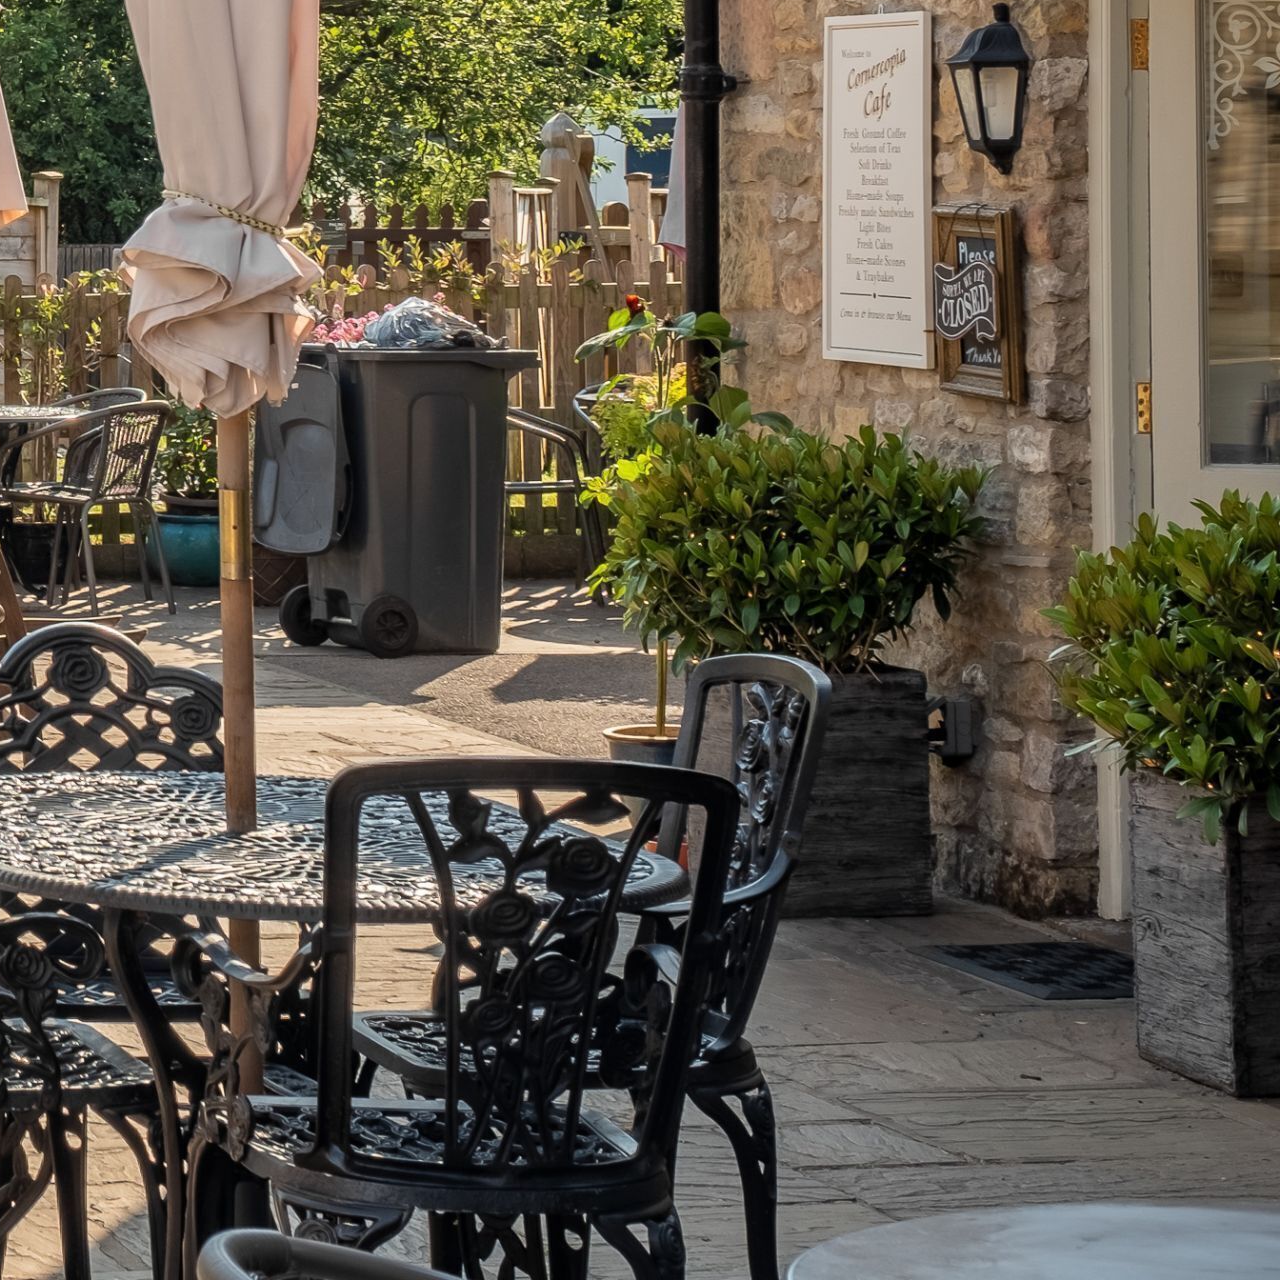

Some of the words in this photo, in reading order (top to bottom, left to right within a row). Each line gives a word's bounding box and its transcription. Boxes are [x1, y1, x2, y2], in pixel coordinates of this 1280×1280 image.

[847, 48, 906, 90] Cornercopia
[863, 82, 892, 121] Cafe
[842, 127, 860, 139] Fresh
[861, 127, 885, 139] Ground
[886, 127, 907, 139] Coffee
[849, 142, 877, 154] Selection
[878, 142, 886, 153] of
[886, 142, 902, 154] Teas
[858, 158, 871, 170] Soft
[871, 158, 892, 170] Drinks
[861, 174, 889, 186] Breakfast
[846, 189, 883, 201] Home-made
[838, 205, 859, 220] Freshly
[860, 206, 877, 217] made
[878, 206, 914, 218] Sandwiches
[859, 221, 875, 235] Light
[876, 222, 892, 233] Bites
[856, 238, 873, 249] Fresh
[874, 238, 894, 250] Cakes
[958, 241, 996, 264] Please
[846, 253, 883, 266] Home-made
[884, 255, 906, 267] Scones
[856, 271, 862, 281] &
[863, 270, 895, 285] Traybakes
[963, 272, 973, 288] WE
[973, 268, 986, 282] ARE
[941, 283, 990, 328] CLOSED
[896, 310, 912, 322] Menu
[966, 347, 993, 363] Thank
